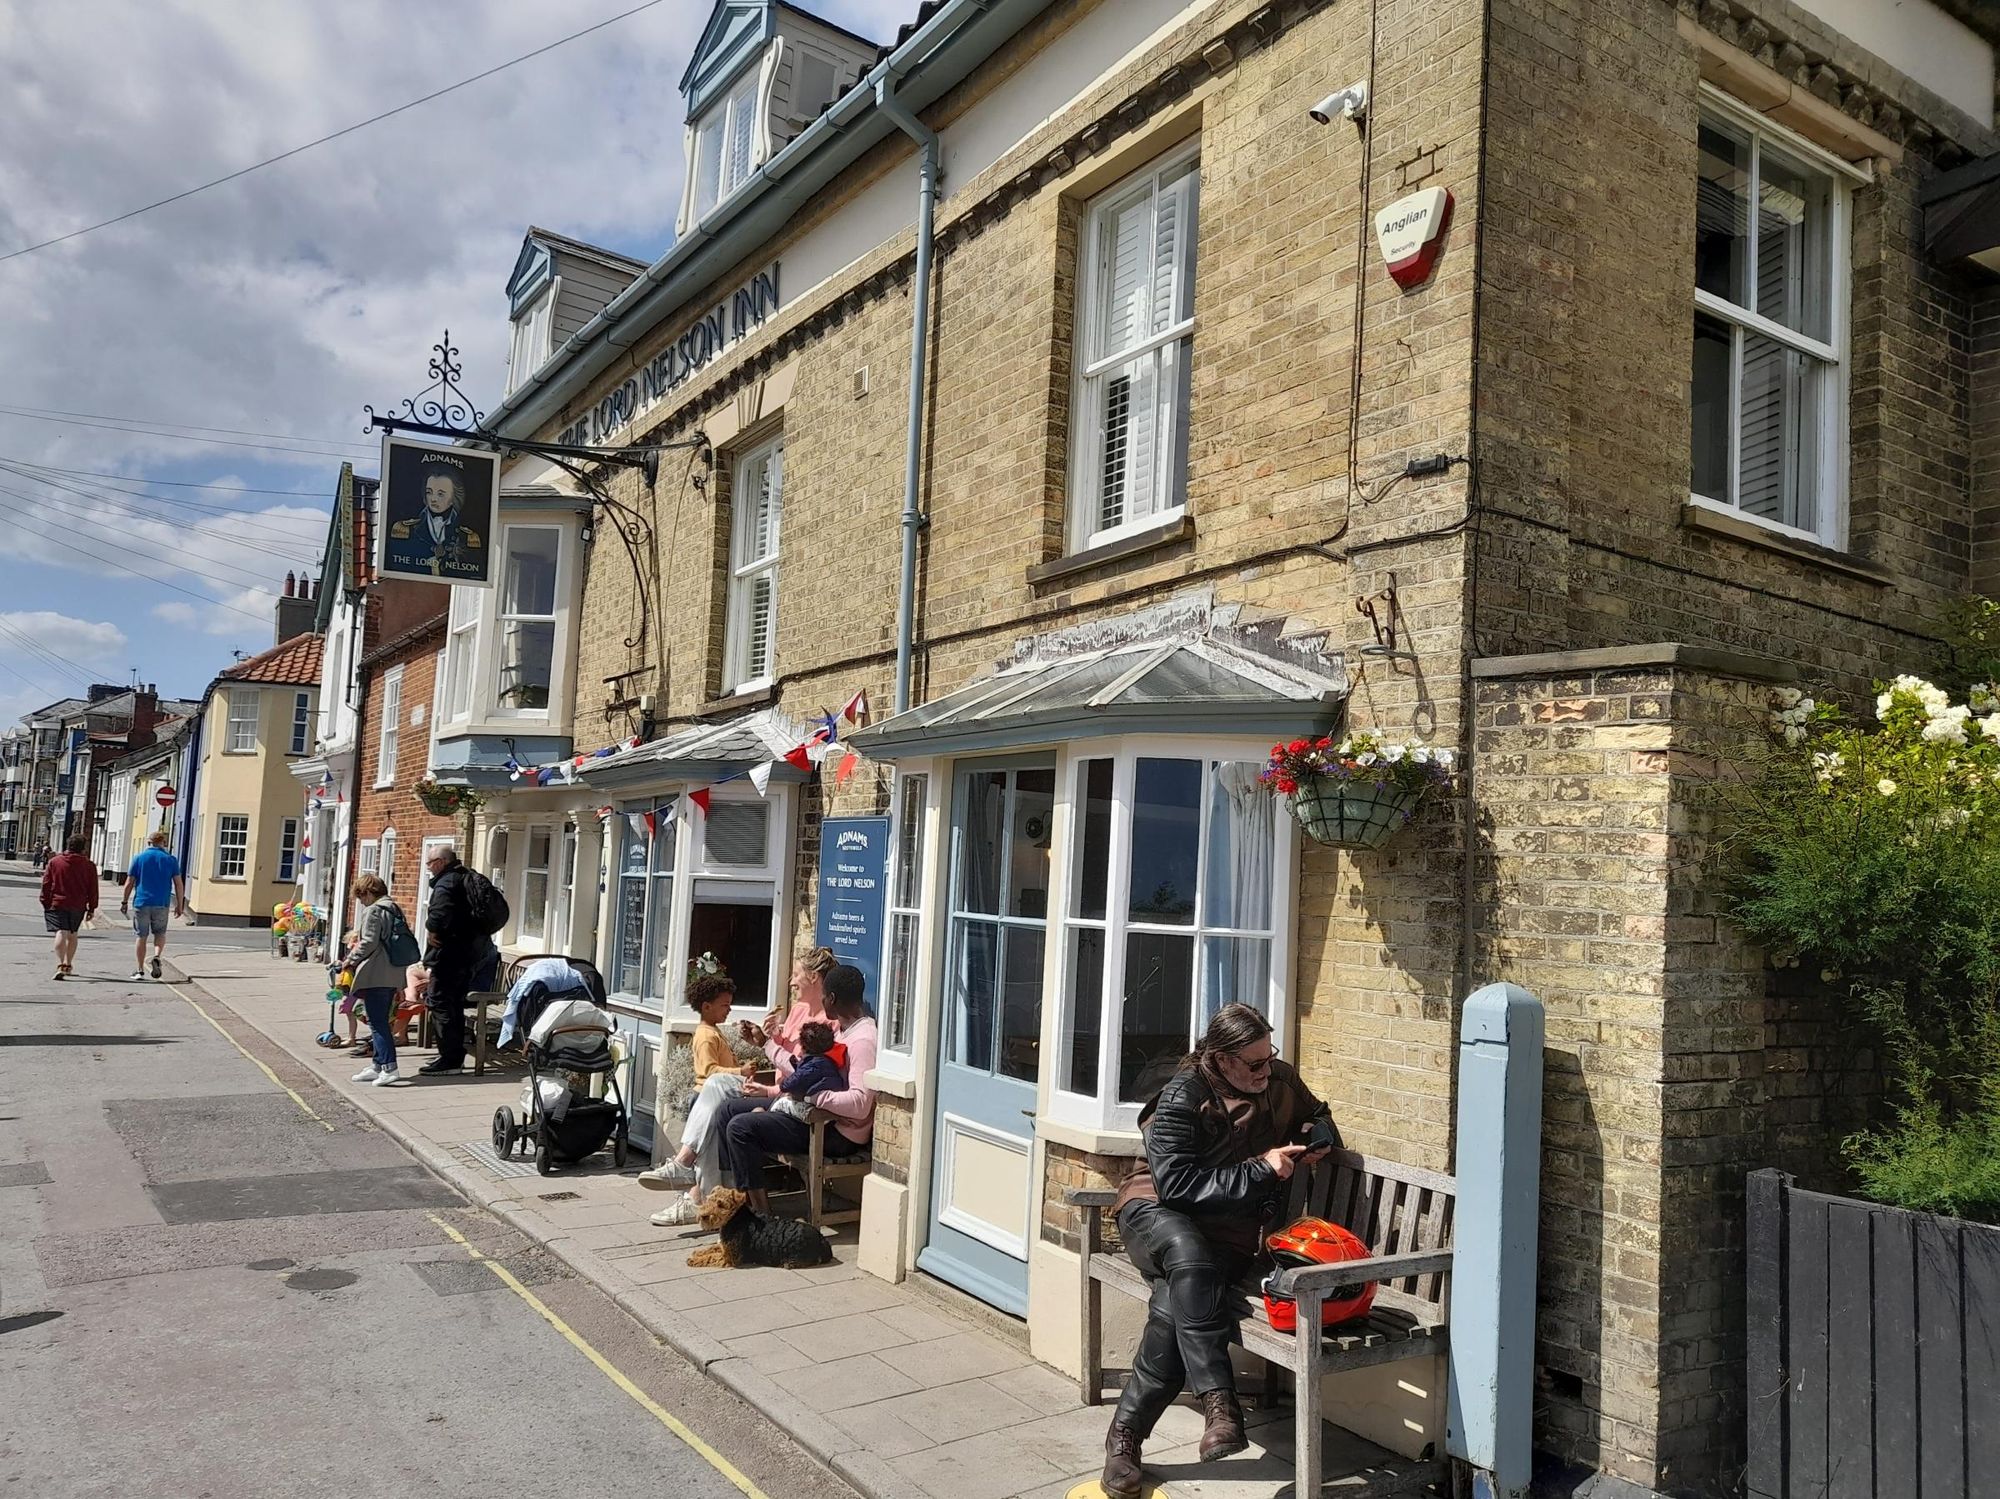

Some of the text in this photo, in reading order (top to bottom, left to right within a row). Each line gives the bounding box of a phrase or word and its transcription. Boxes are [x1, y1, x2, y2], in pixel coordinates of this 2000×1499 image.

[1382, 208, 1427, 236] Anglian
[1391, 241, 1415, 255] Security
[592, 378, 639, 445] LORD
[640, 305, 725, 409] NELSON
[732, 260, 781, 342] INN
[421, 453, 464, 470] ADNAMS
[393, 554, 479, 572] THE LORD NELSON
[836, 830, 868, 849] ADNAMS
[837, 863, 865, 873] Welcome to
[826, 877, 875, 889] THE LORD NELSON
[832, 911, 865, 922] Adnams beers &
[852, 924, 867, 936] spirits
[834, 935, 858, 945] served here
